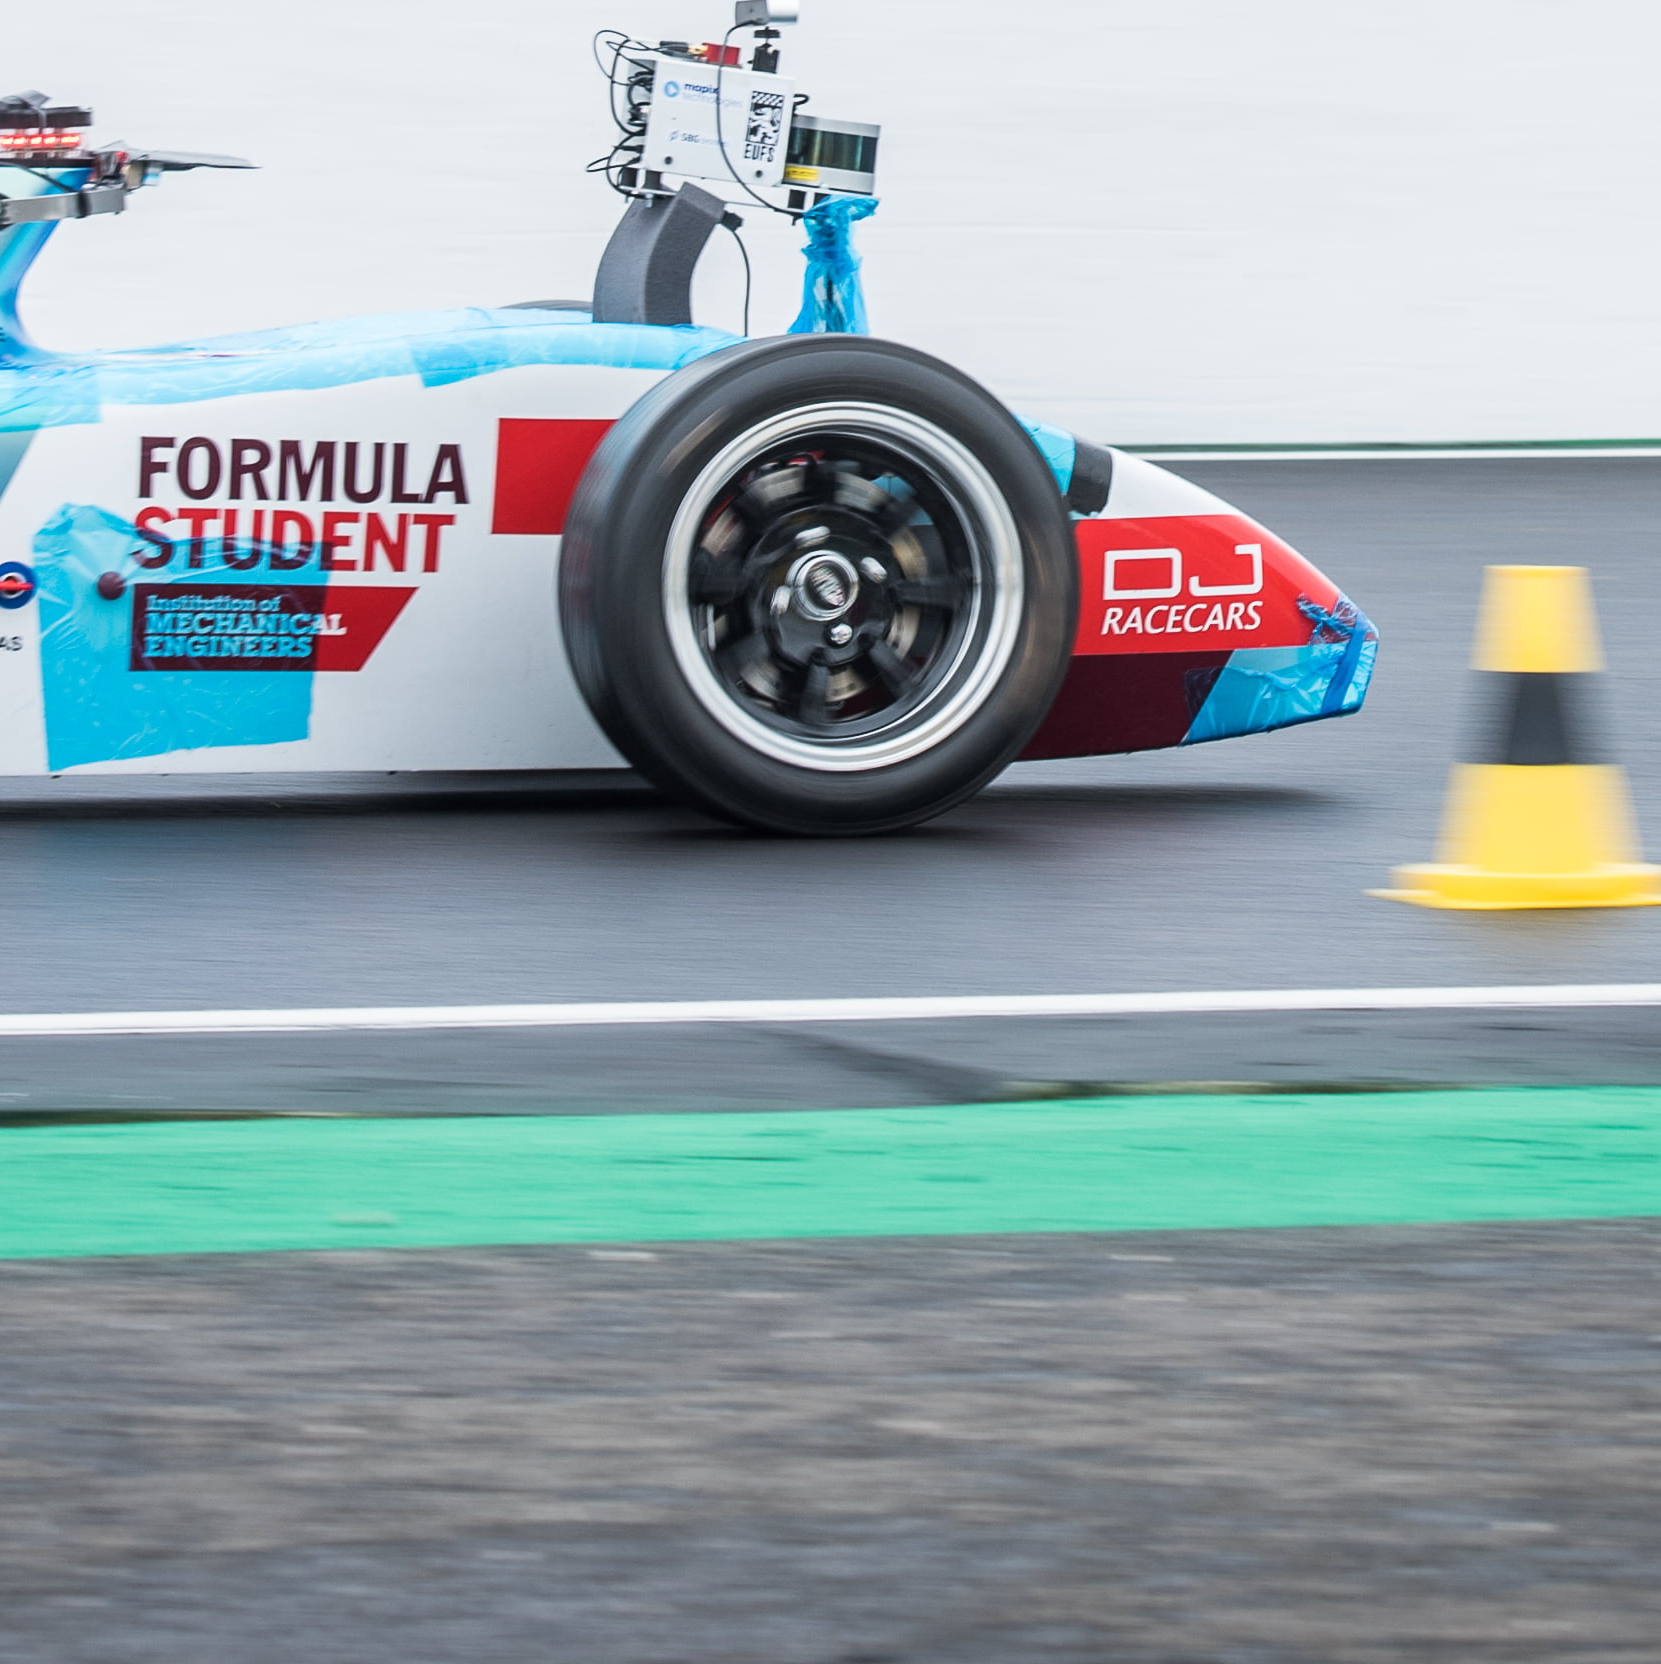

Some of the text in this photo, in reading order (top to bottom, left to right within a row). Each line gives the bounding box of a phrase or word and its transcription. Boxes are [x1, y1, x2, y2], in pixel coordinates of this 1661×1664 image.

[744, 143, 775, 163] EUFS
[137, 436, 471, 504] FORMULA
[132, 506, 457, 573] STUDENT
[1103, 543, 1264, 600] DJ
[145, 595, 282, 612] Institution of
[144, 613, 347, 635] MECHANICAL
[1100, 601, 1264, 636] RACECARS
[144, 635, 312, 658] ENGINEERS
